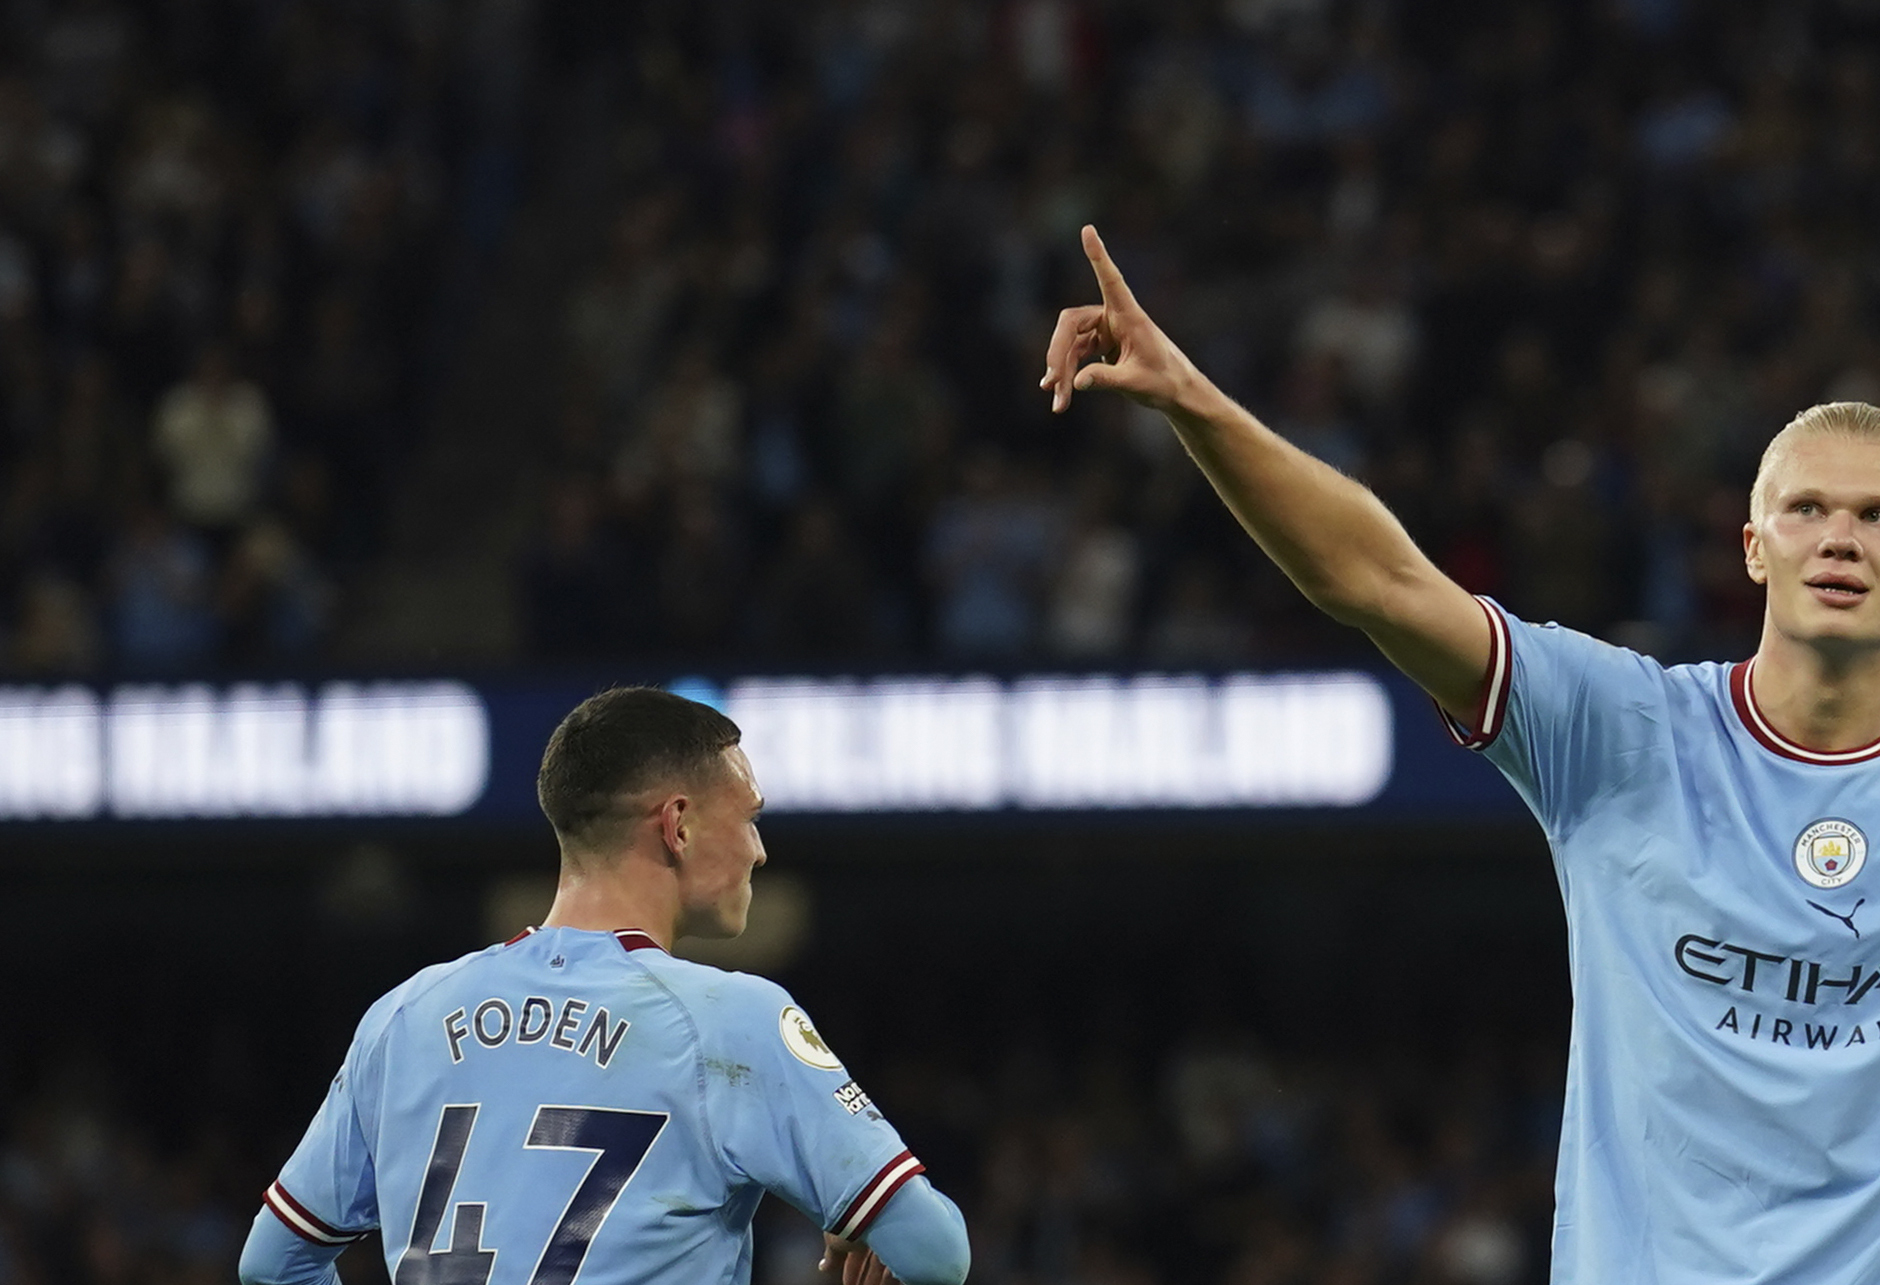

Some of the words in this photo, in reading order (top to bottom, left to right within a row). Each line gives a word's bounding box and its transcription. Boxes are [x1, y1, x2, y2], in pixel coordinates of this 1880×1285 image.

[1801, 823, 1862, 847] MANCHESTER
[1821, 877, 1843, 886] CITY
[442, 997, 630, 1069] FODEN
